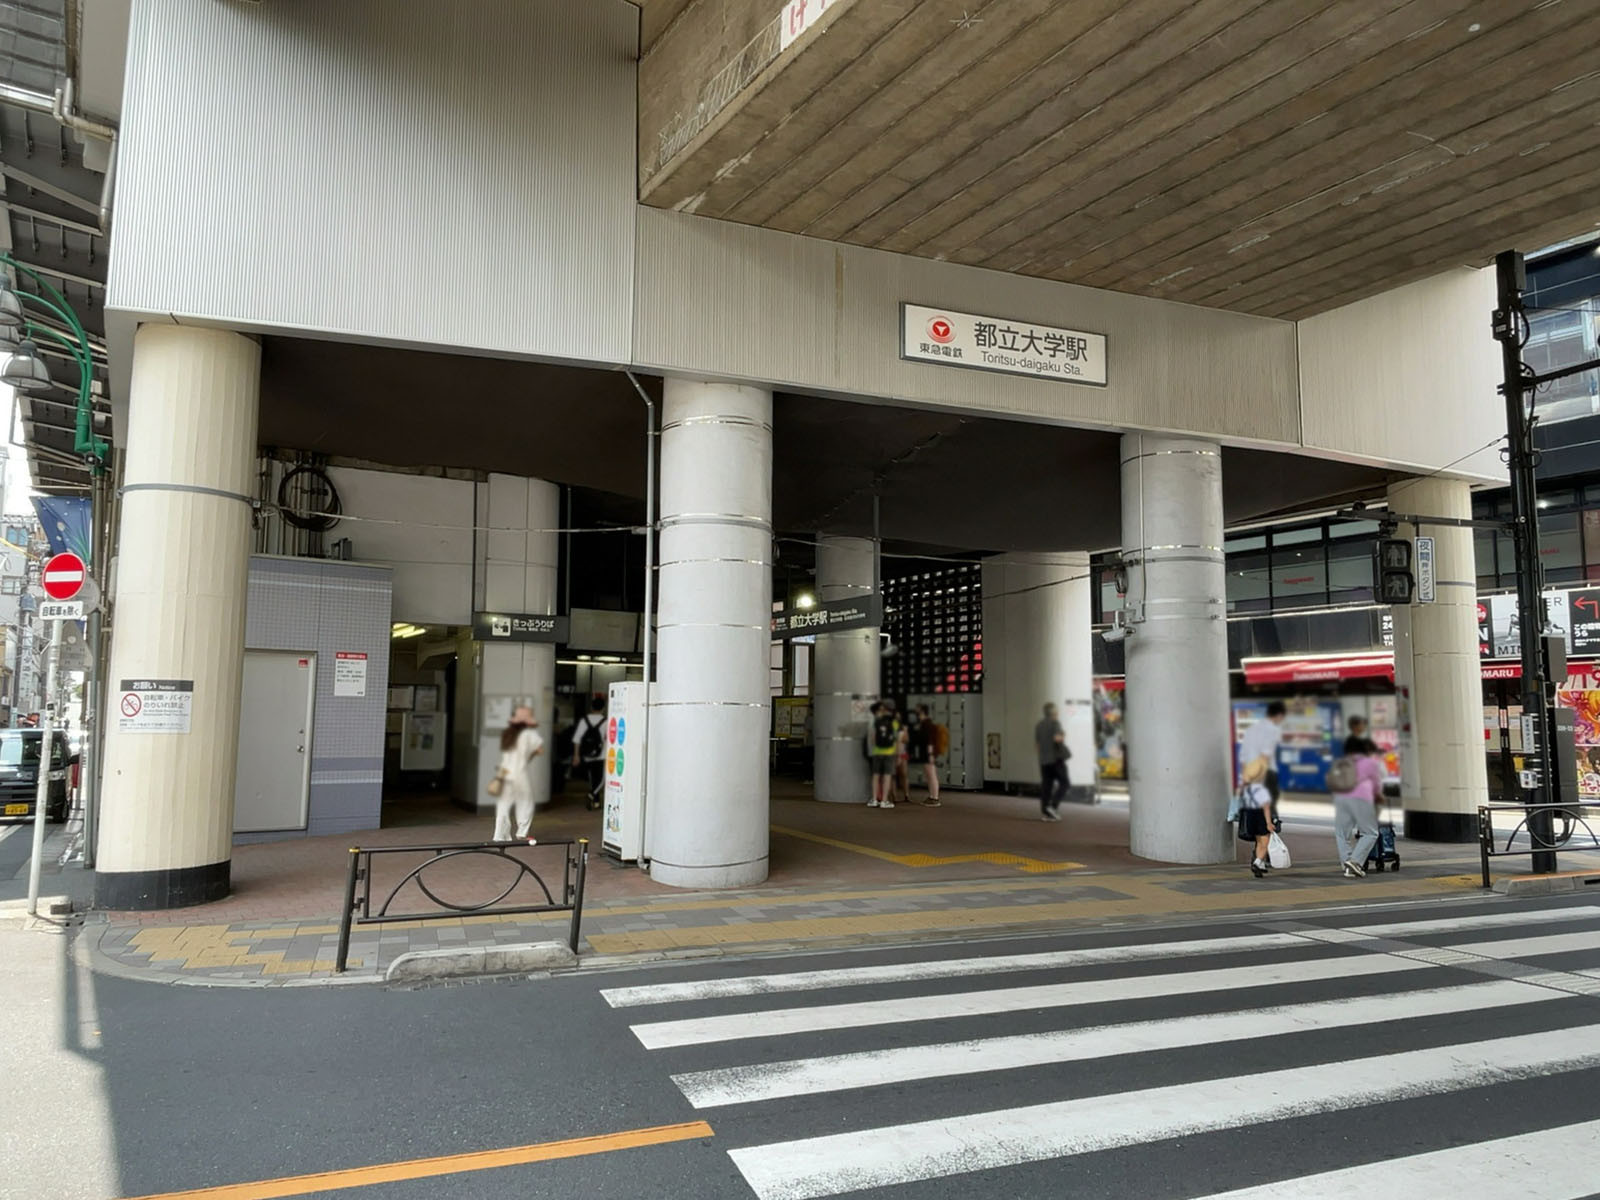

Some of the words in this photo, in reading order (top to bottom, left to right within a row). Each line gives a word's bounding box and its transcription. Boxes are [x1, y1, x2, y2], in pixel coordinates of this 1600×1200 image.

[974, 321, 1087, 361] 都立大学駅
[919, 342, 963, 358] 東急電鉄
[981, 351, 1060, 373] Toritsu-daigaku
[1063, 362, 1084, 375] Sta.
[42, 605, 79, 616] 自転車を除く
[513, 619, 554, 628] きっぷうりば
[790, 610, 827, 629] 都立大学駅
[132, 681, 157, 690] お願い
